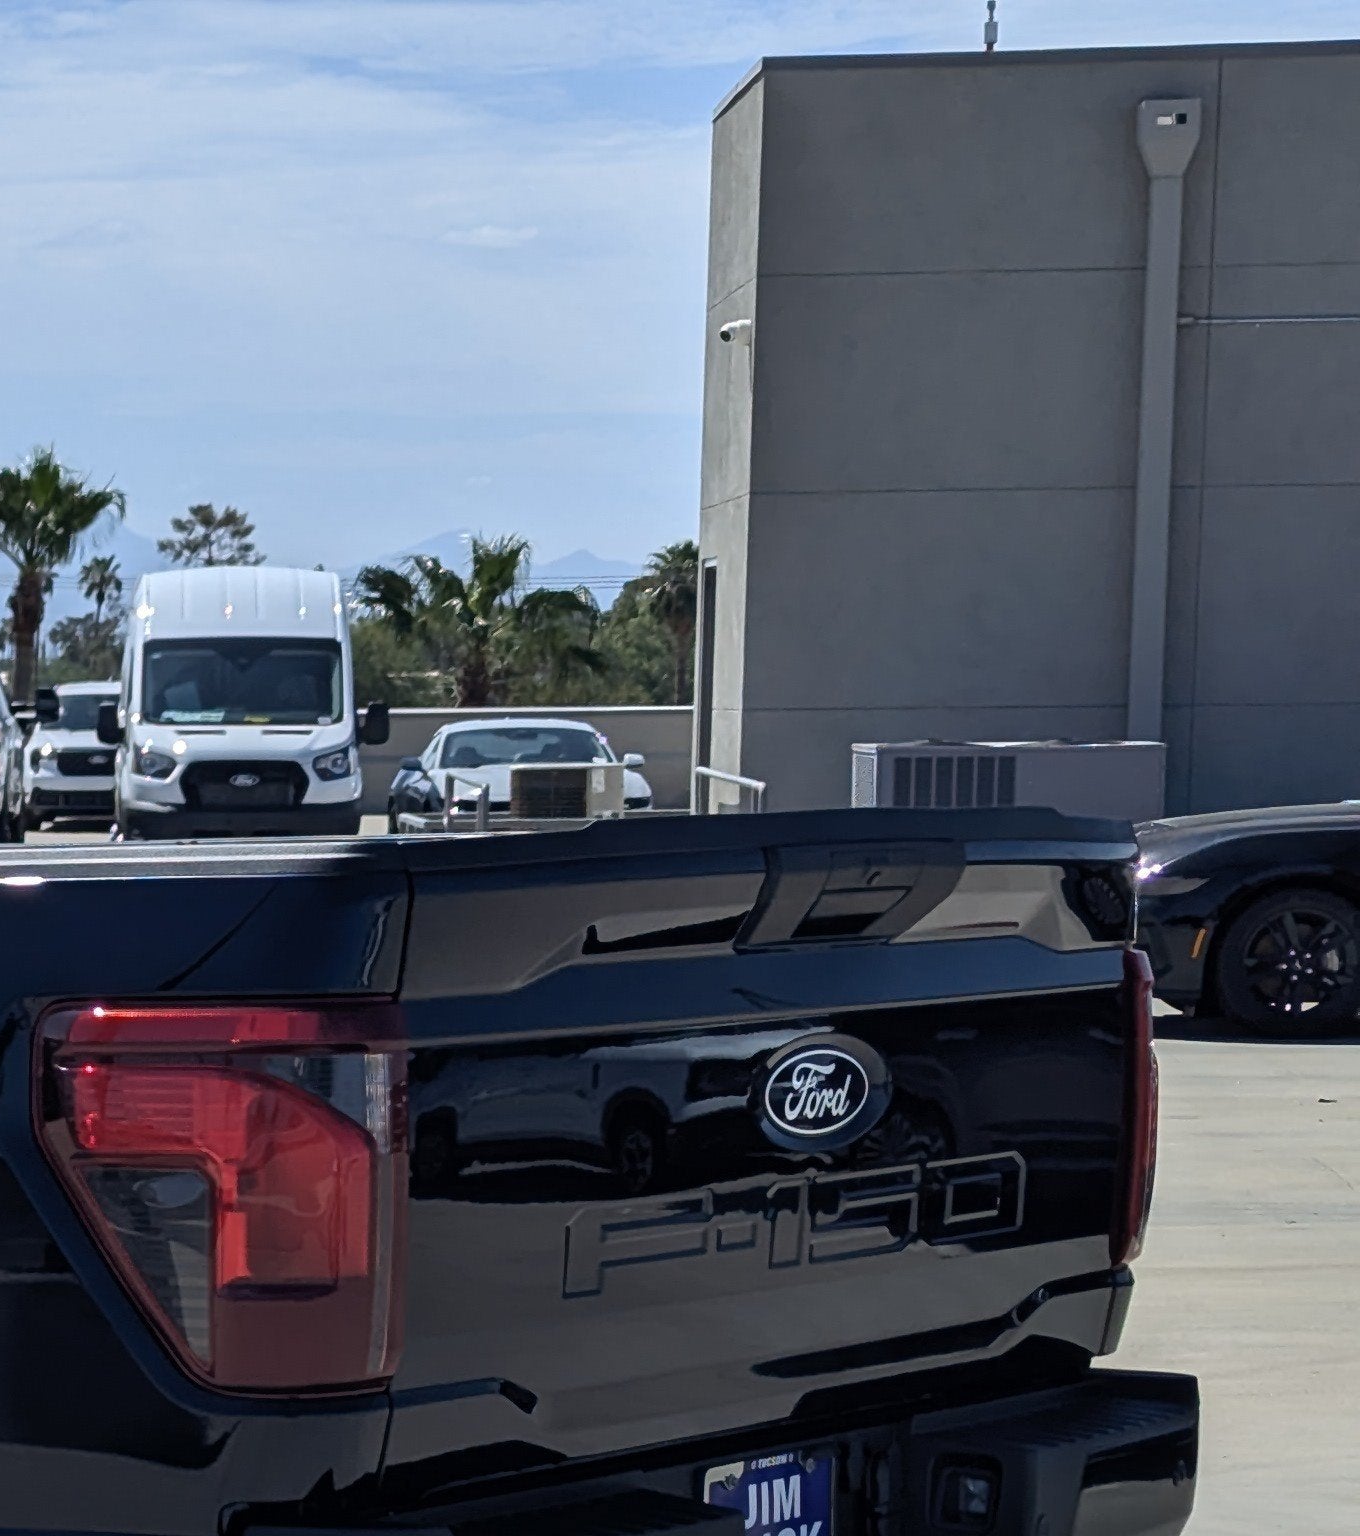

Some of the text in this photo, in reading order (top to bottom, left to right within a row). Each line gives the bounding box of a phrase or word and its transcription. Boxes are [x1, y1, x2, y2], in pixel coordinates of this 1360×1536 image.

[784, 1062, 851, 1120] Ford
[562, 1150, 1027, 1300] F-150
[745, 1474, 801, 1530] JIM
